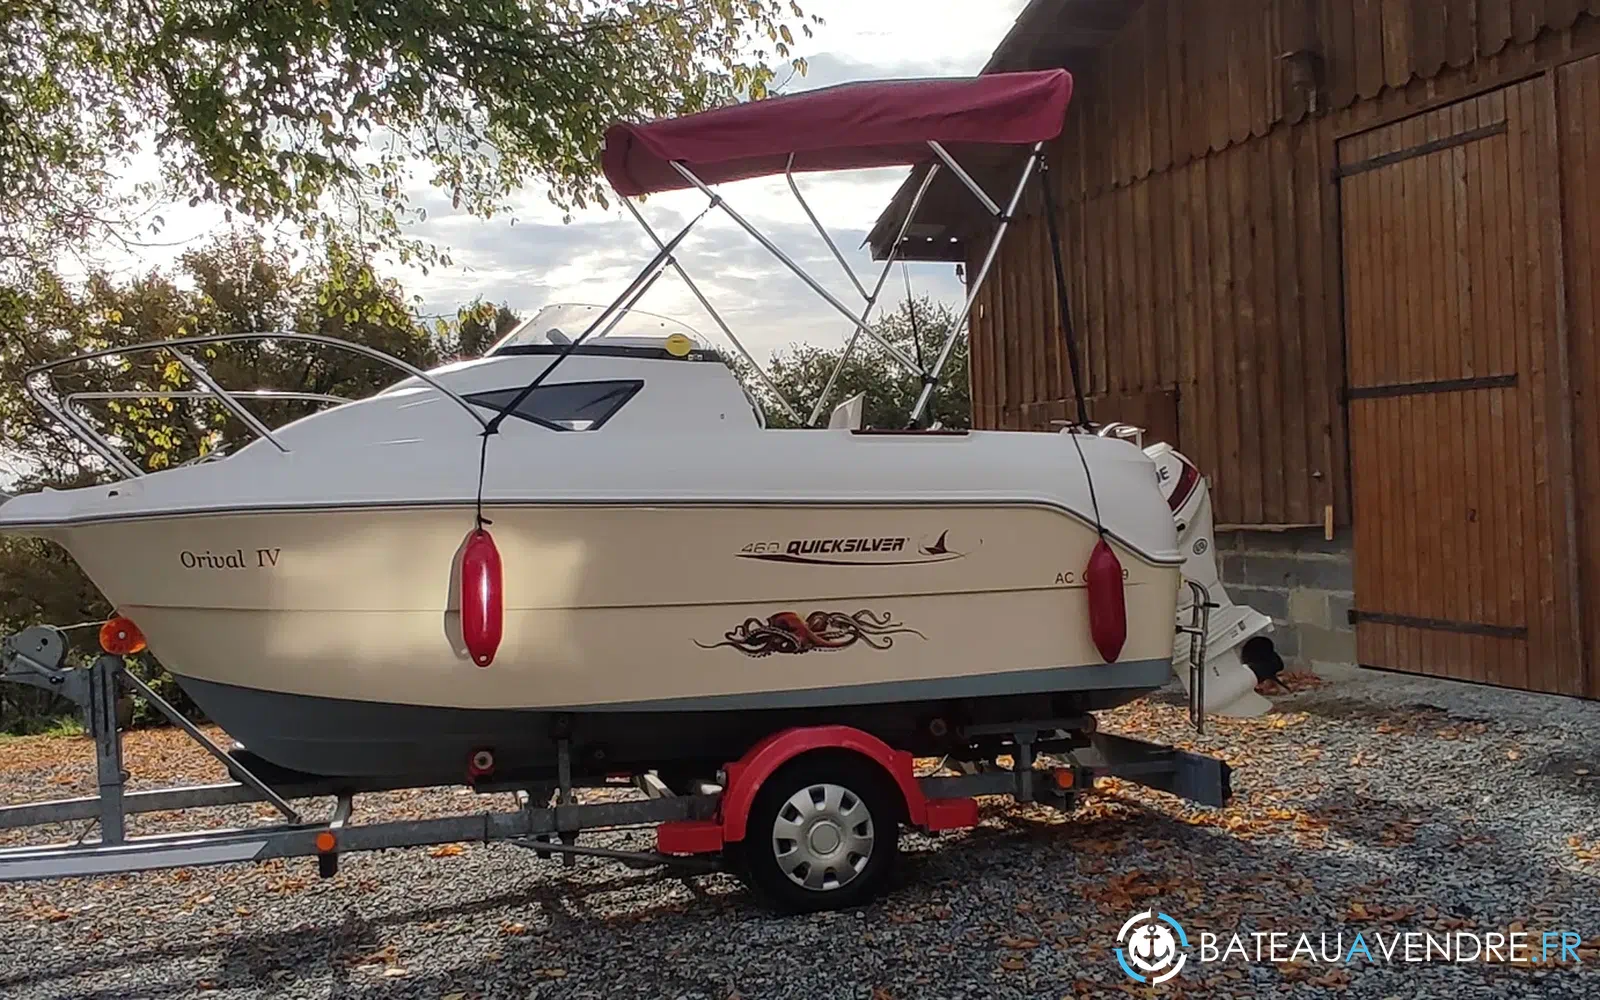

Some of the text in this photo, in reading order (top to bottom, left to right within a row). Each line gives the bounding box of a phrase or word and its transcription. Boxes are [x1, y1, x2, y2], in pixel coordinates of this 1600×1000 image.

[741, 537, 905, 555] 460 QUICKSILVER
[180, 548, 281, 569] Orival IV
[1055, 571, 1074, 585] AC
